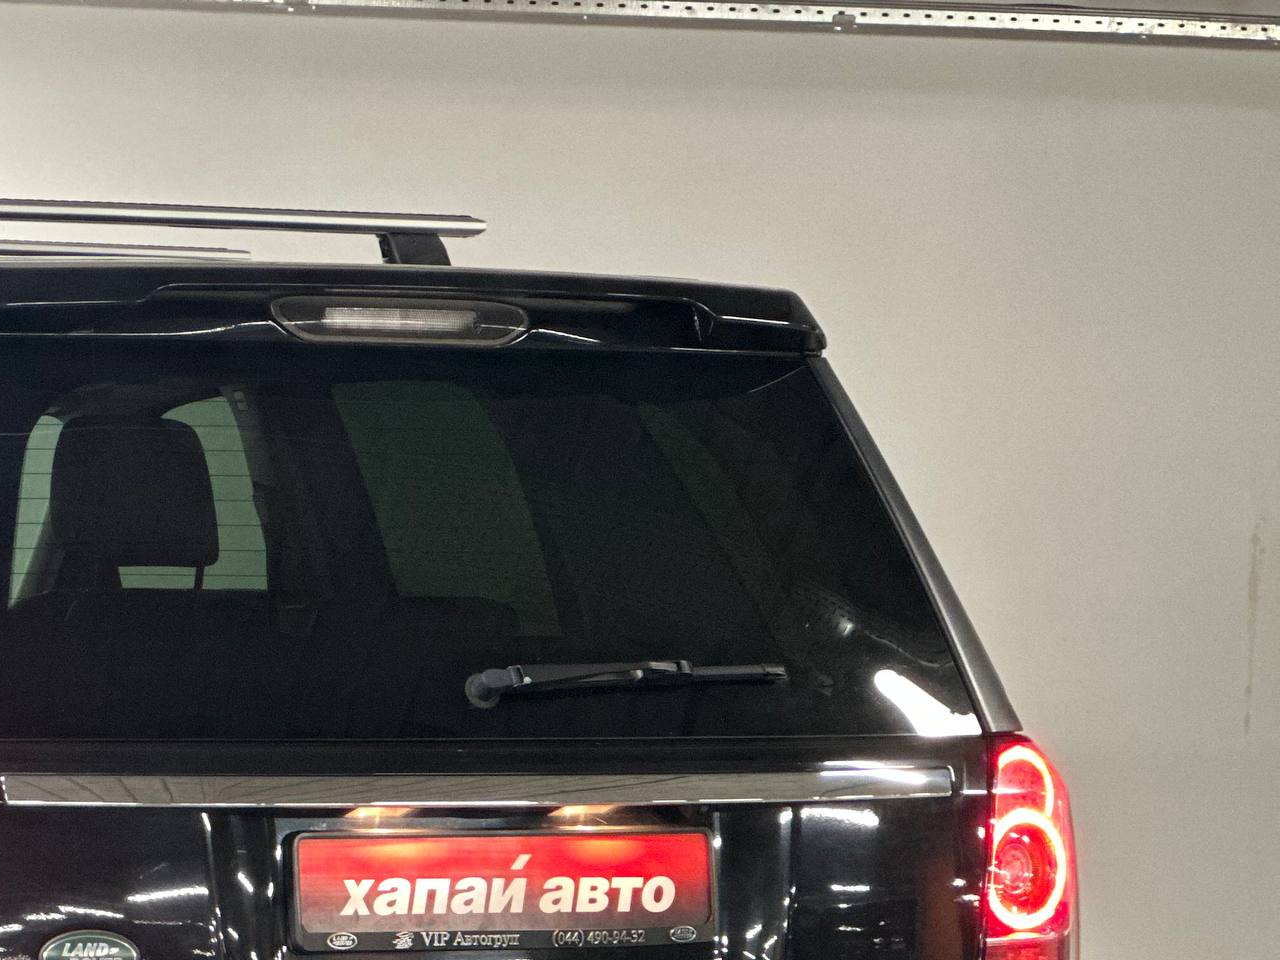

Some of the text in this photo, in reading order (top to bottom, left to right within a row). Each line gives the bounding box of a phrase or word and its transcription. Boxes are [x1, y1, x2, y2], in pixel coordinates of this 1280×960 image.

[539, 875, 676, 914] авто
[420, 931, 450, 947] VIP
[552, 929, 584, 948] (044)
[61, 942, 110, 957] LAND
